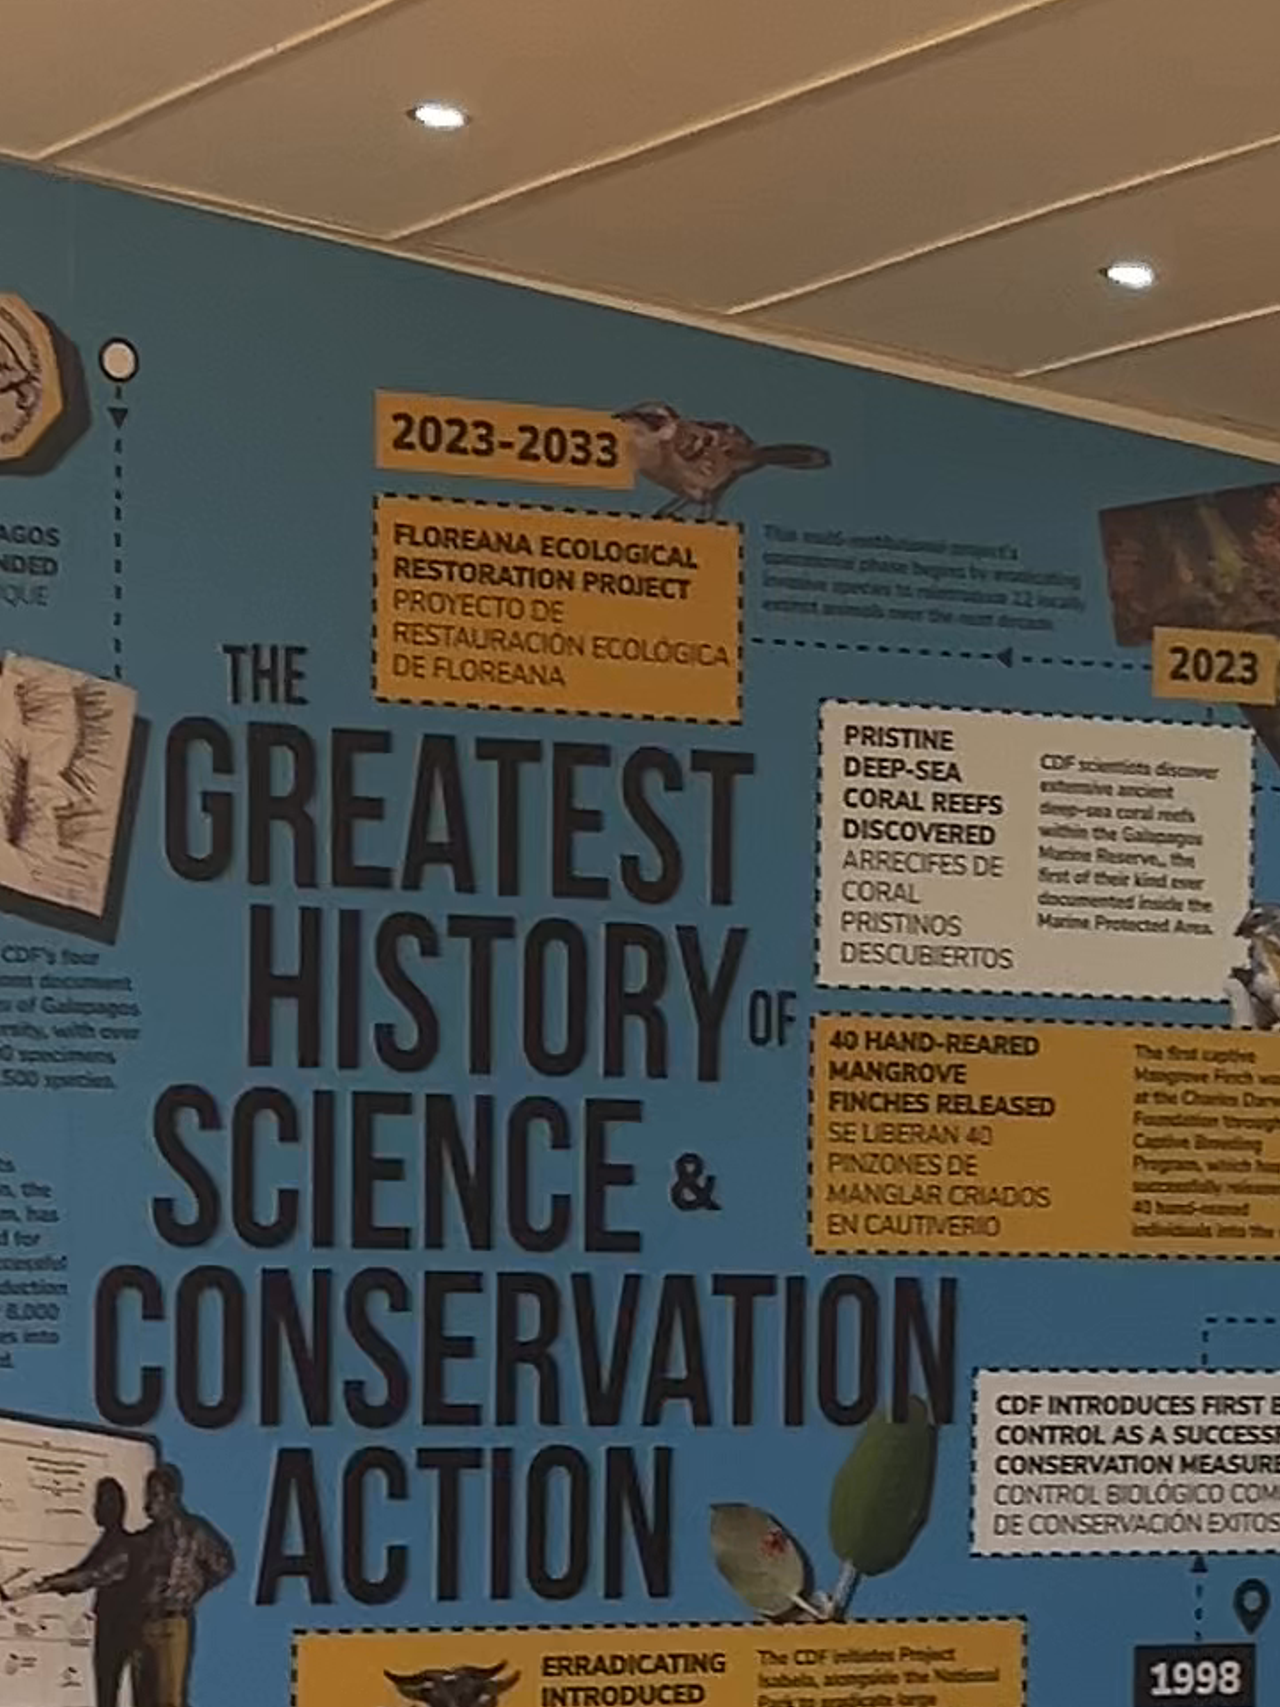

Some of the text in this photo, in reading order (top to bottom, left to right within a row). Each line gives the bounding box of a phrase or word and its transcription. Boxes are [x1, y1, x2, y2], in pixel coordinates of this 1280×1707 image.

[393, 413, 618, 467] 2023-2033
[394, 524, 698, 569] FLOREANA ECOLOGICAL
[394, 559, 691, 600] RESTORATION PROJECT
[393, 591, 563, 623] PROYECTO DE
[223, 645, 307, 706] THE
[393, 655, 566, 686] DE FLOREANA
[1170, 648, 1258, 684] 2023
[845, 726, 953, 750] PRISTINE
[845, 757, 962, 782] DEEP-SEA
[164, 716, 754, 906] GREATEST
[844, 789, 1003, 815] CORAL REEFS
[844, 820, 995, 845] DISCOVERED
[843, 850, 1002, 877] ARRECIFES DE
[842, 882, 920, 903] CORAL
[841, 912, 961, 936] PRISTINOS
[841, 943, 1013, 968] DESCUBIERTOS
[247, 905, 749, 1082] HISTORY
[749, 990, 798, 1046] OF
[830, 1031, 1039, 1056] 40 HAND-REARED
[829, 1062, 966, 1084] MANGROVE
[829, 1092, 1055, 1116] FINCHES RELEASED
[828, 1122, 992, 1145] SE LIBERAN 40
[152, 1085, 643, 1253] SCIENCE
[829, 1153, 978, 1176] PINZONES DE
[670, 1153, 721, 1211] &
[827, 1184, 1051, 1207] MANGLAR CRIADOS
[95, 1266, 954, 1428] CONSERVATION
[996, 1395, 1042, 1416] CDF
[1049, 1395, 1195, 1416] INTRODUCES
[1203, 1395, 1265, 1415] FIRST
[996, 1425, 1105, 1446] CONTROL
[1113, 1425, 1143, 1445] AS
[1149, 1425, 1167, 1445] A
[995, 1455, 1173, 1474] CONSERVATION
[256, 1445, 672, 1604] ACTION
[994, 1515, 1022, 1534] DE
[1029, 1509, 1202, 1534] CONSERVACIÓN
[543, 1654, 725, 1676] ERRADICATING
[1152, 1661, 1240, 1695] 1998
[542, 1684, 705, 1707] INTRODUCED
